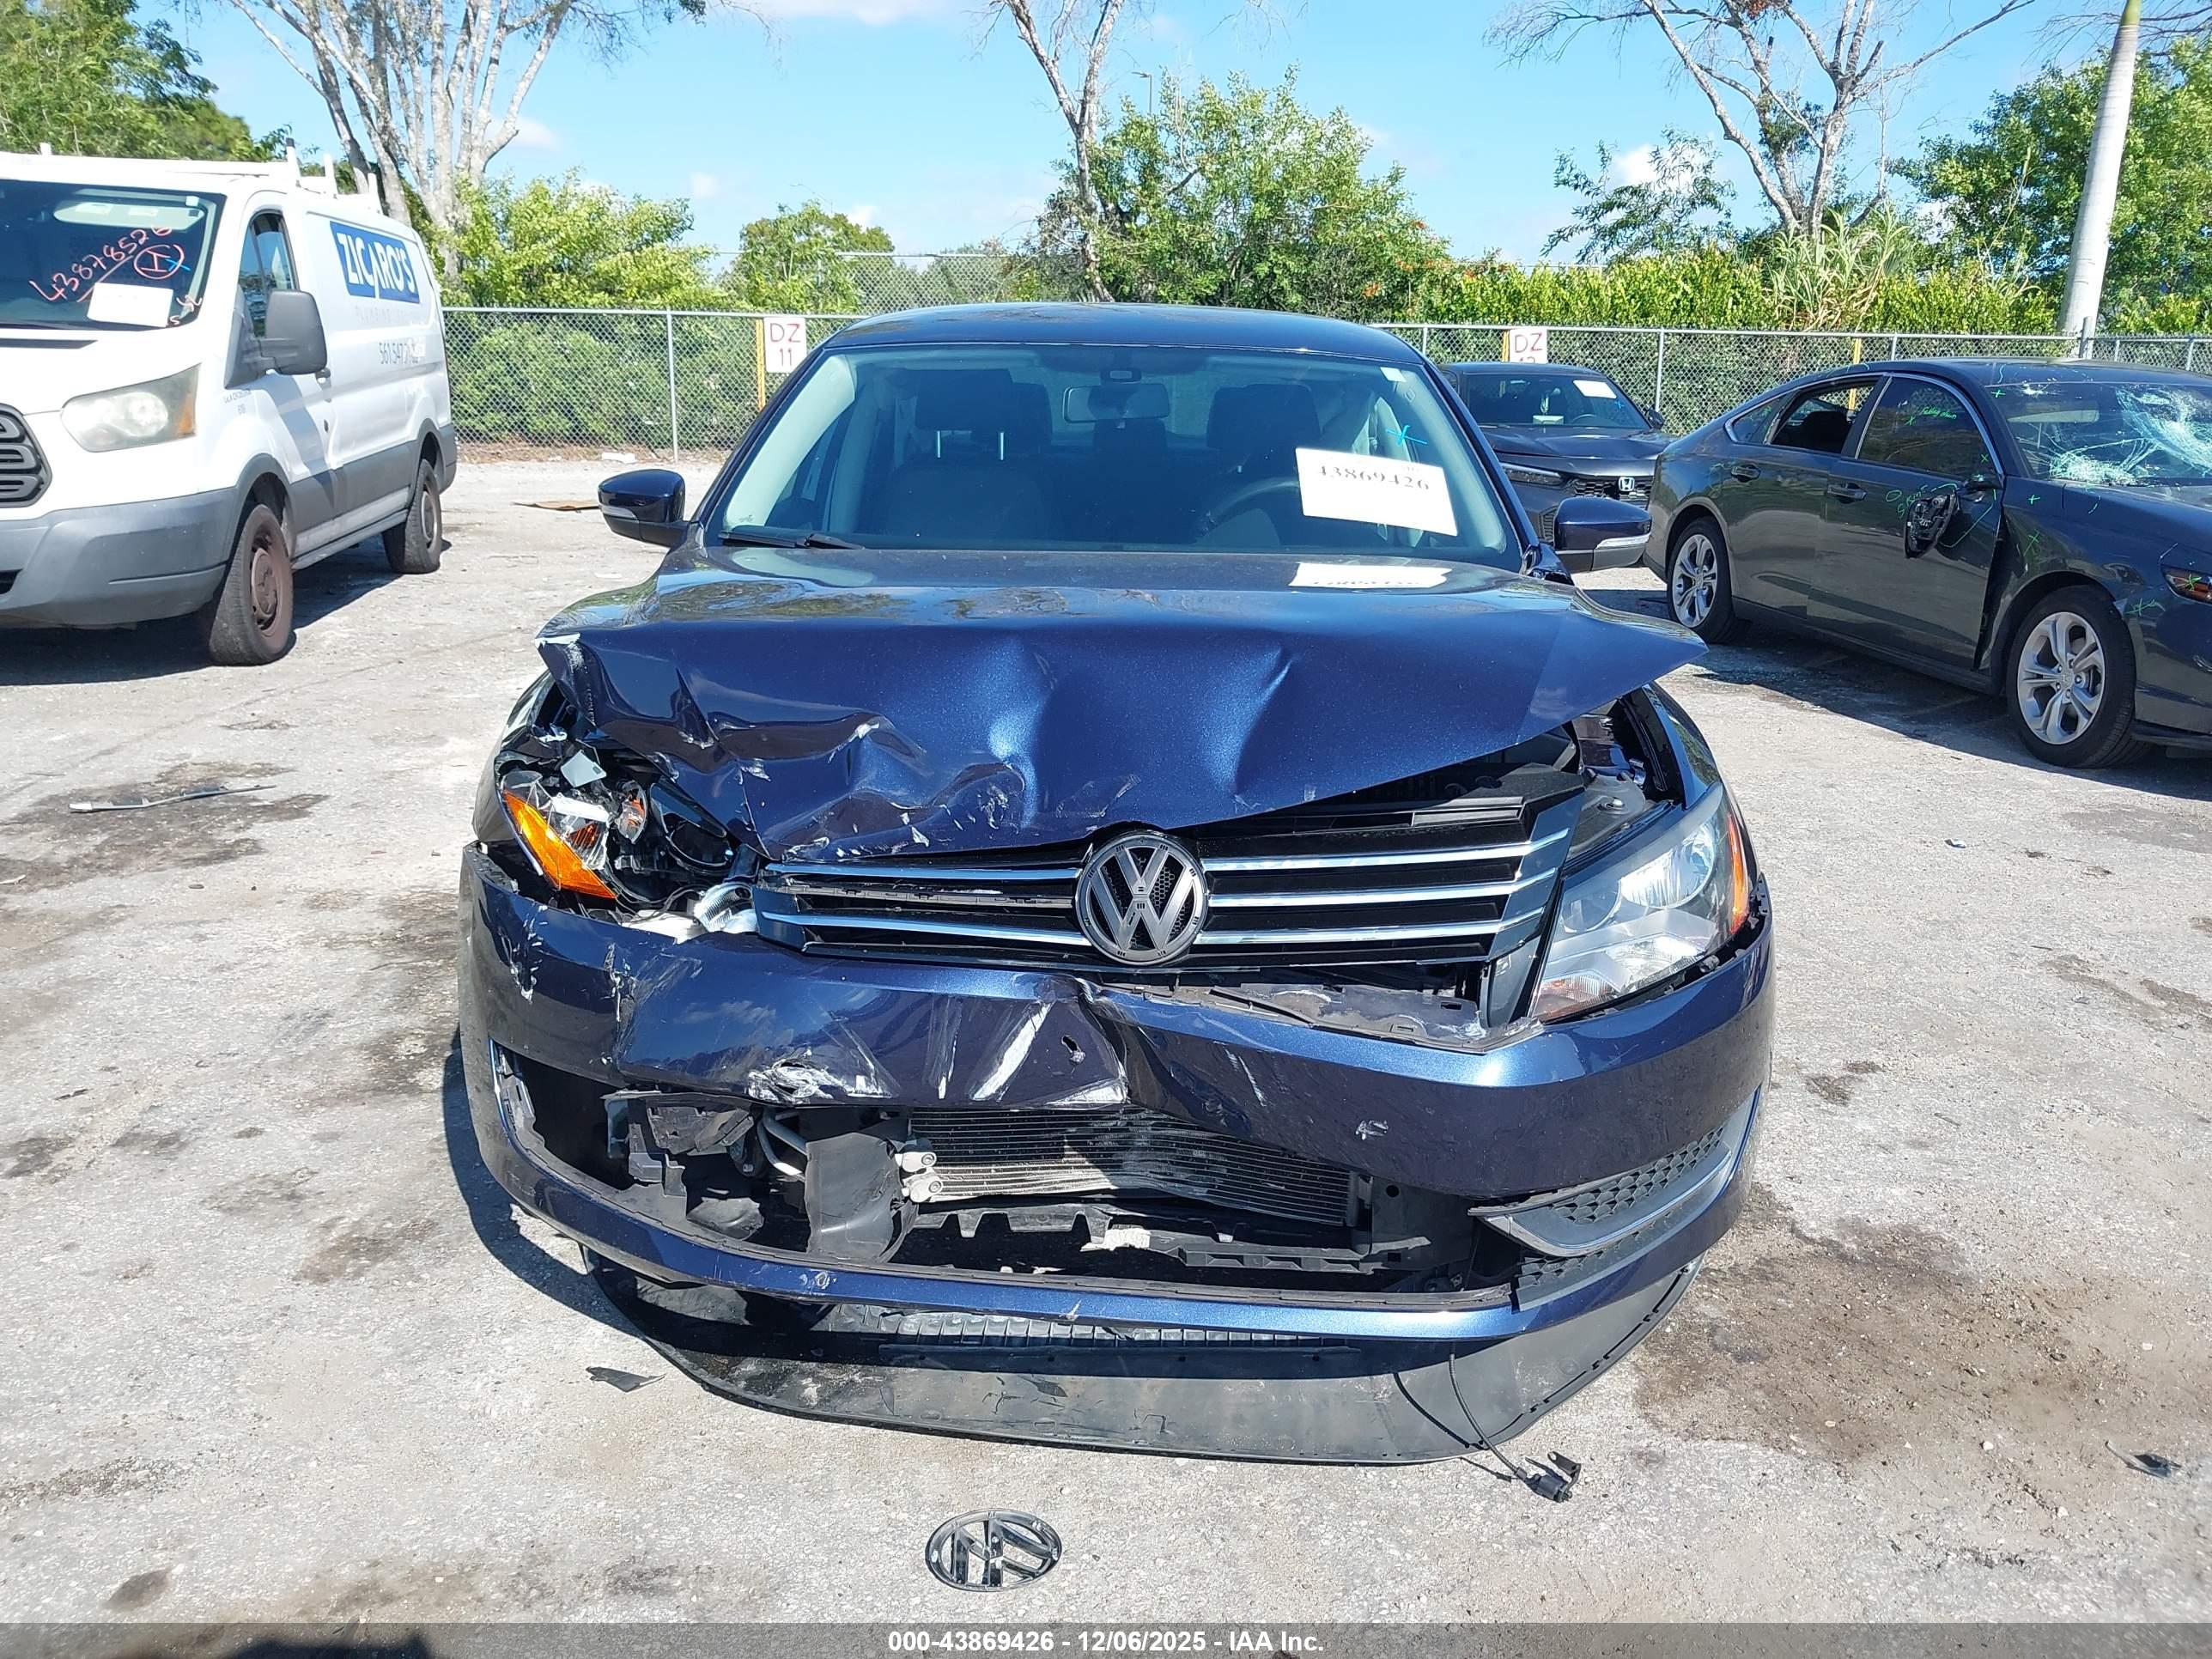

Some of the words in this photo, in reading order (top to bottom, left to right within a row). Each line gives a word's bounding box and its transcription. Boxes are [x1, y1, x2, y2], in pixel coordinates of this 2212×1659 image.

[336, 233, 416, 298] ZICARO'S
[769, 322, 802, 343] DZ
[1514, 331, 1544, 353] DZ
[780, 347, 793, 367] 11
